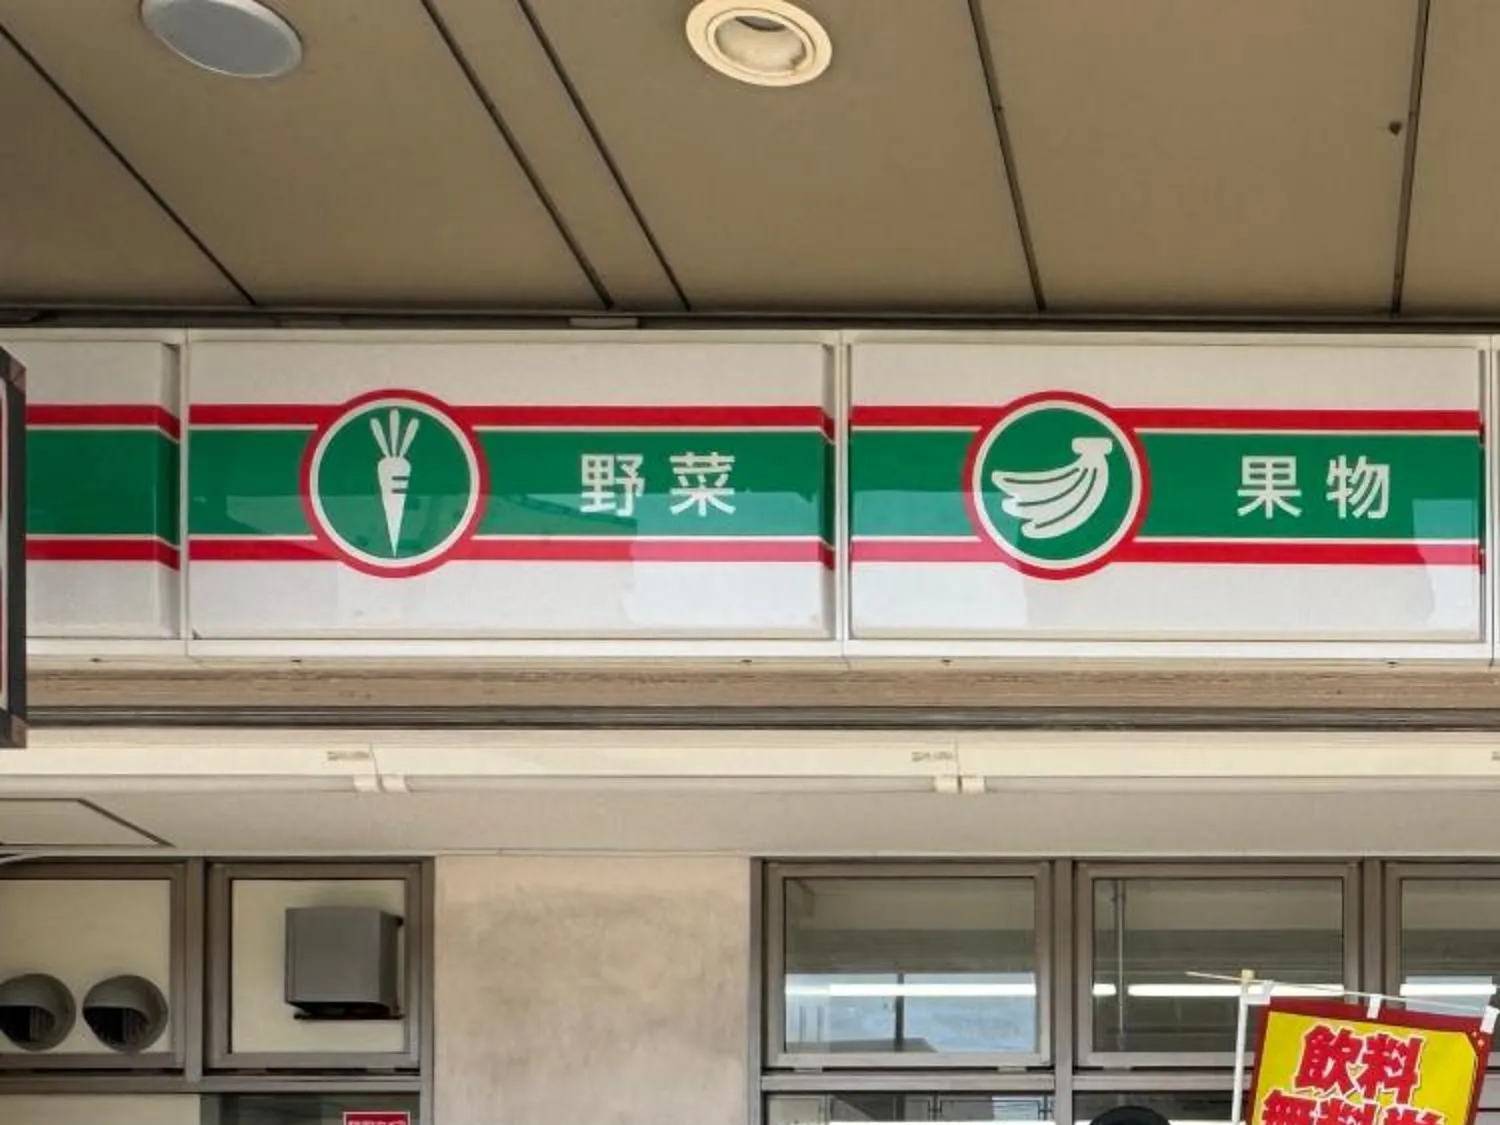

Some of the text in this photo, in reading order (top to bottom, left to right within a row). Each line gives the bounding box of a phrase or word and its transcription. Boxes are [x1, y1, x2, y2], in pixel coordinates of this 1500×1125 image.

[580, 452, 737, 517] 野菜
[1237, 455, 1391, 520] 果物
[1295, 1024, 1423, 1105] 飲料
